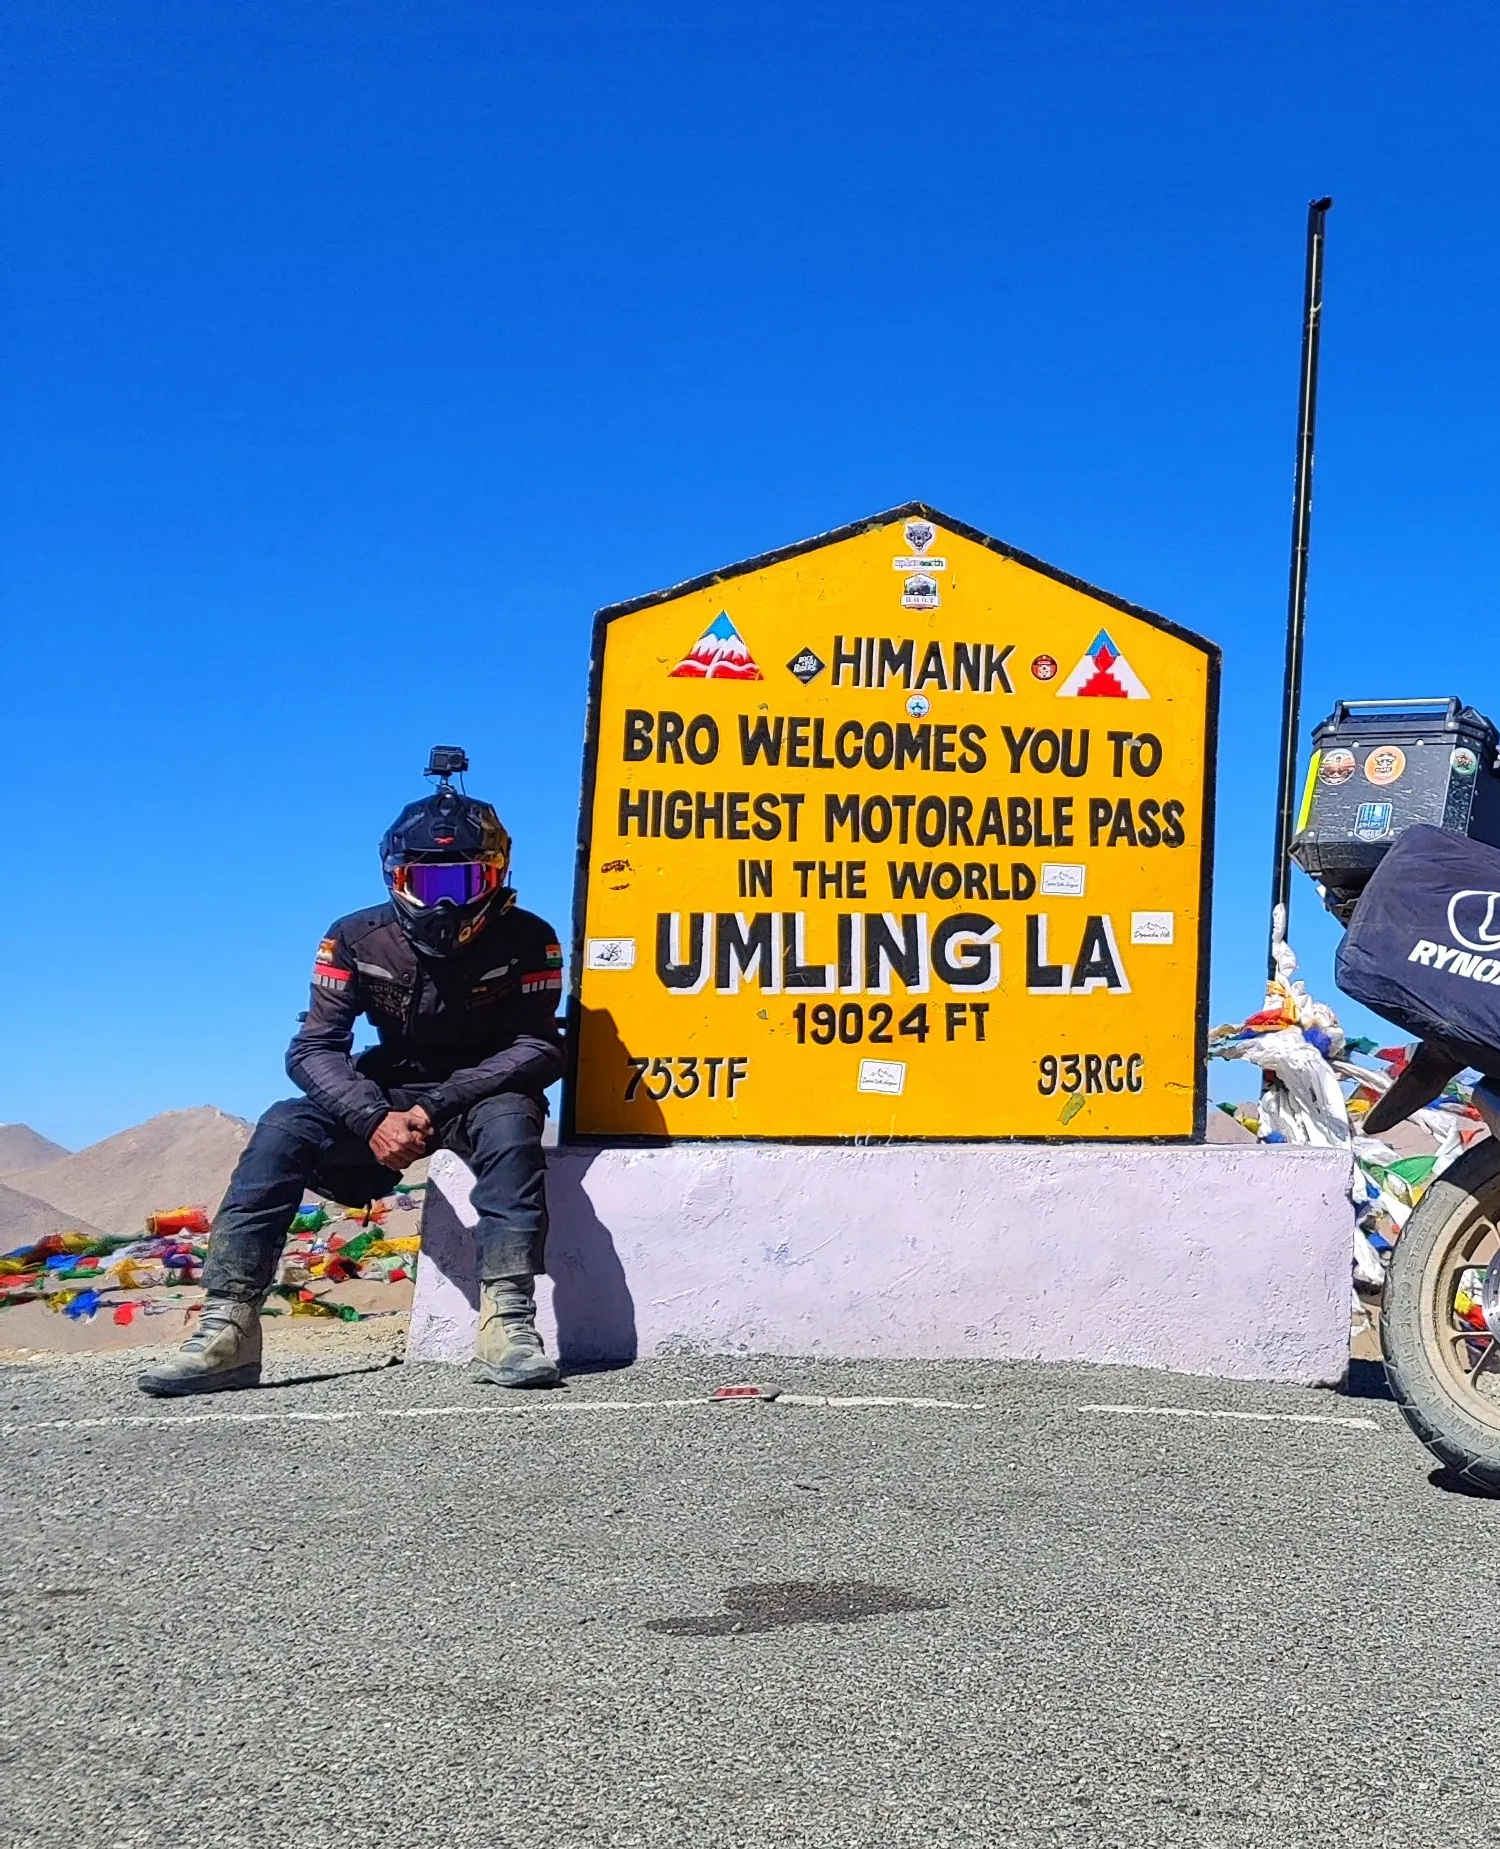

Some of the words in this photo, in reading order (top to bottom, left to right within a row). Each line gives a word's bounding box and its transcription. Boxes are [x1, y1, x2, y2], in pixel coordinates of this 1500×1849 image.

[832, 635, 1016, 693] HIMANK
[623, 709, 720, 765] BRO
[739, 714, 987, 773] WELCOMES
[1001, 726, 1090, 777] YOU
[1107, 731, 1163, 777] TO
[618, 788, 805, 842] HIGHEST
[825, 794, 1074, 847] MOTORABLE
[1090, 798, 1185, 848] PASS
[738, 859, 773, 898] IN
[793, 860, 867, 899] THE
[888, 861, 1036, 901] WORLD
[656, 912, 1001, 994] UMLING
[1026, 913, 1132, 995] LA
[792, 1002, 930, 1045] 19024
[945, 1002, 990, 1042] FT
[624, 1056, 748, 1101] 753TF
